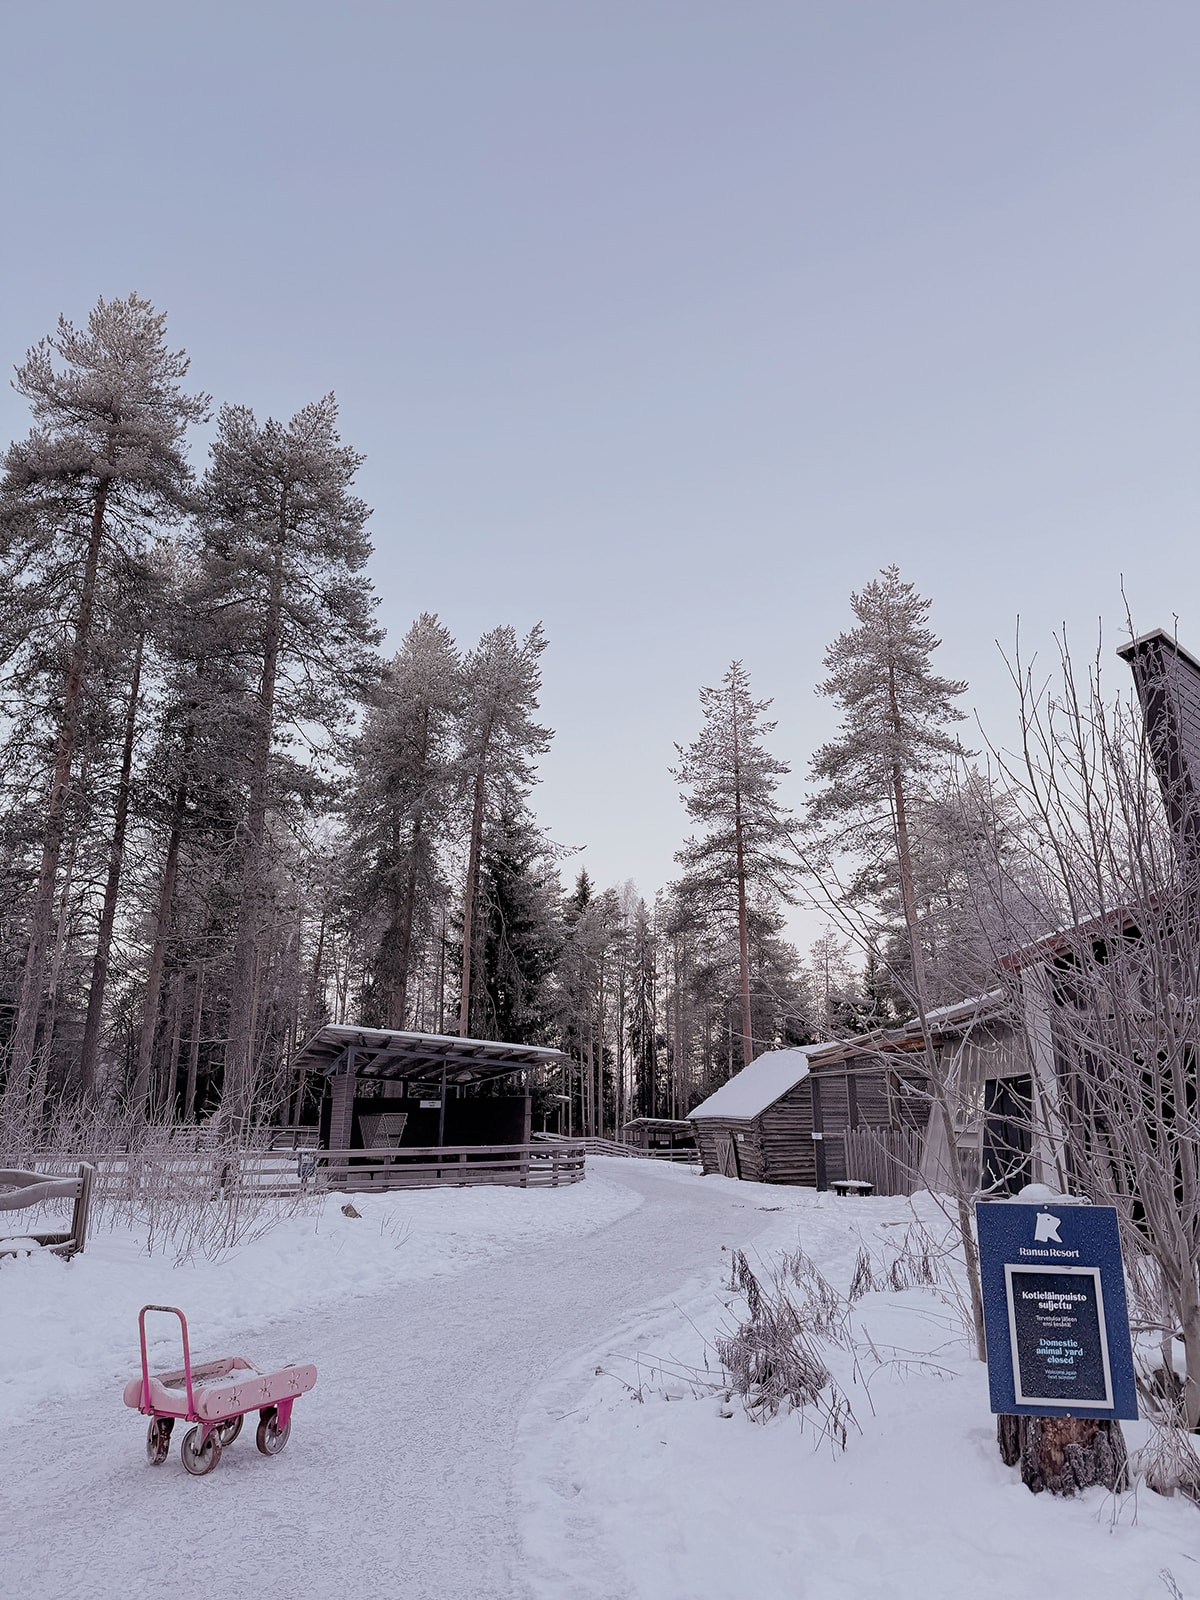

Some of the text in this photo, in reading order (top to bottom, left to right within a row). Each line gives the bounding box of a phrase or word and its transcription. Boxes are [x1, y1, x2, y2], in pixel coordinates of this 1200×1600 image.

[1019, 1247, 1080, 1258] Ranua Resort
[1022, 1291, 1087, 1302] Kotieläinpuisto
[1038, 1301, 1072, 1311] suljettu
[1039, 1338, 1078, 1347] Domestic
[1036, 1347, 1083, 1356] animal yard
[1047, 1355, 1074, 1364] closed
